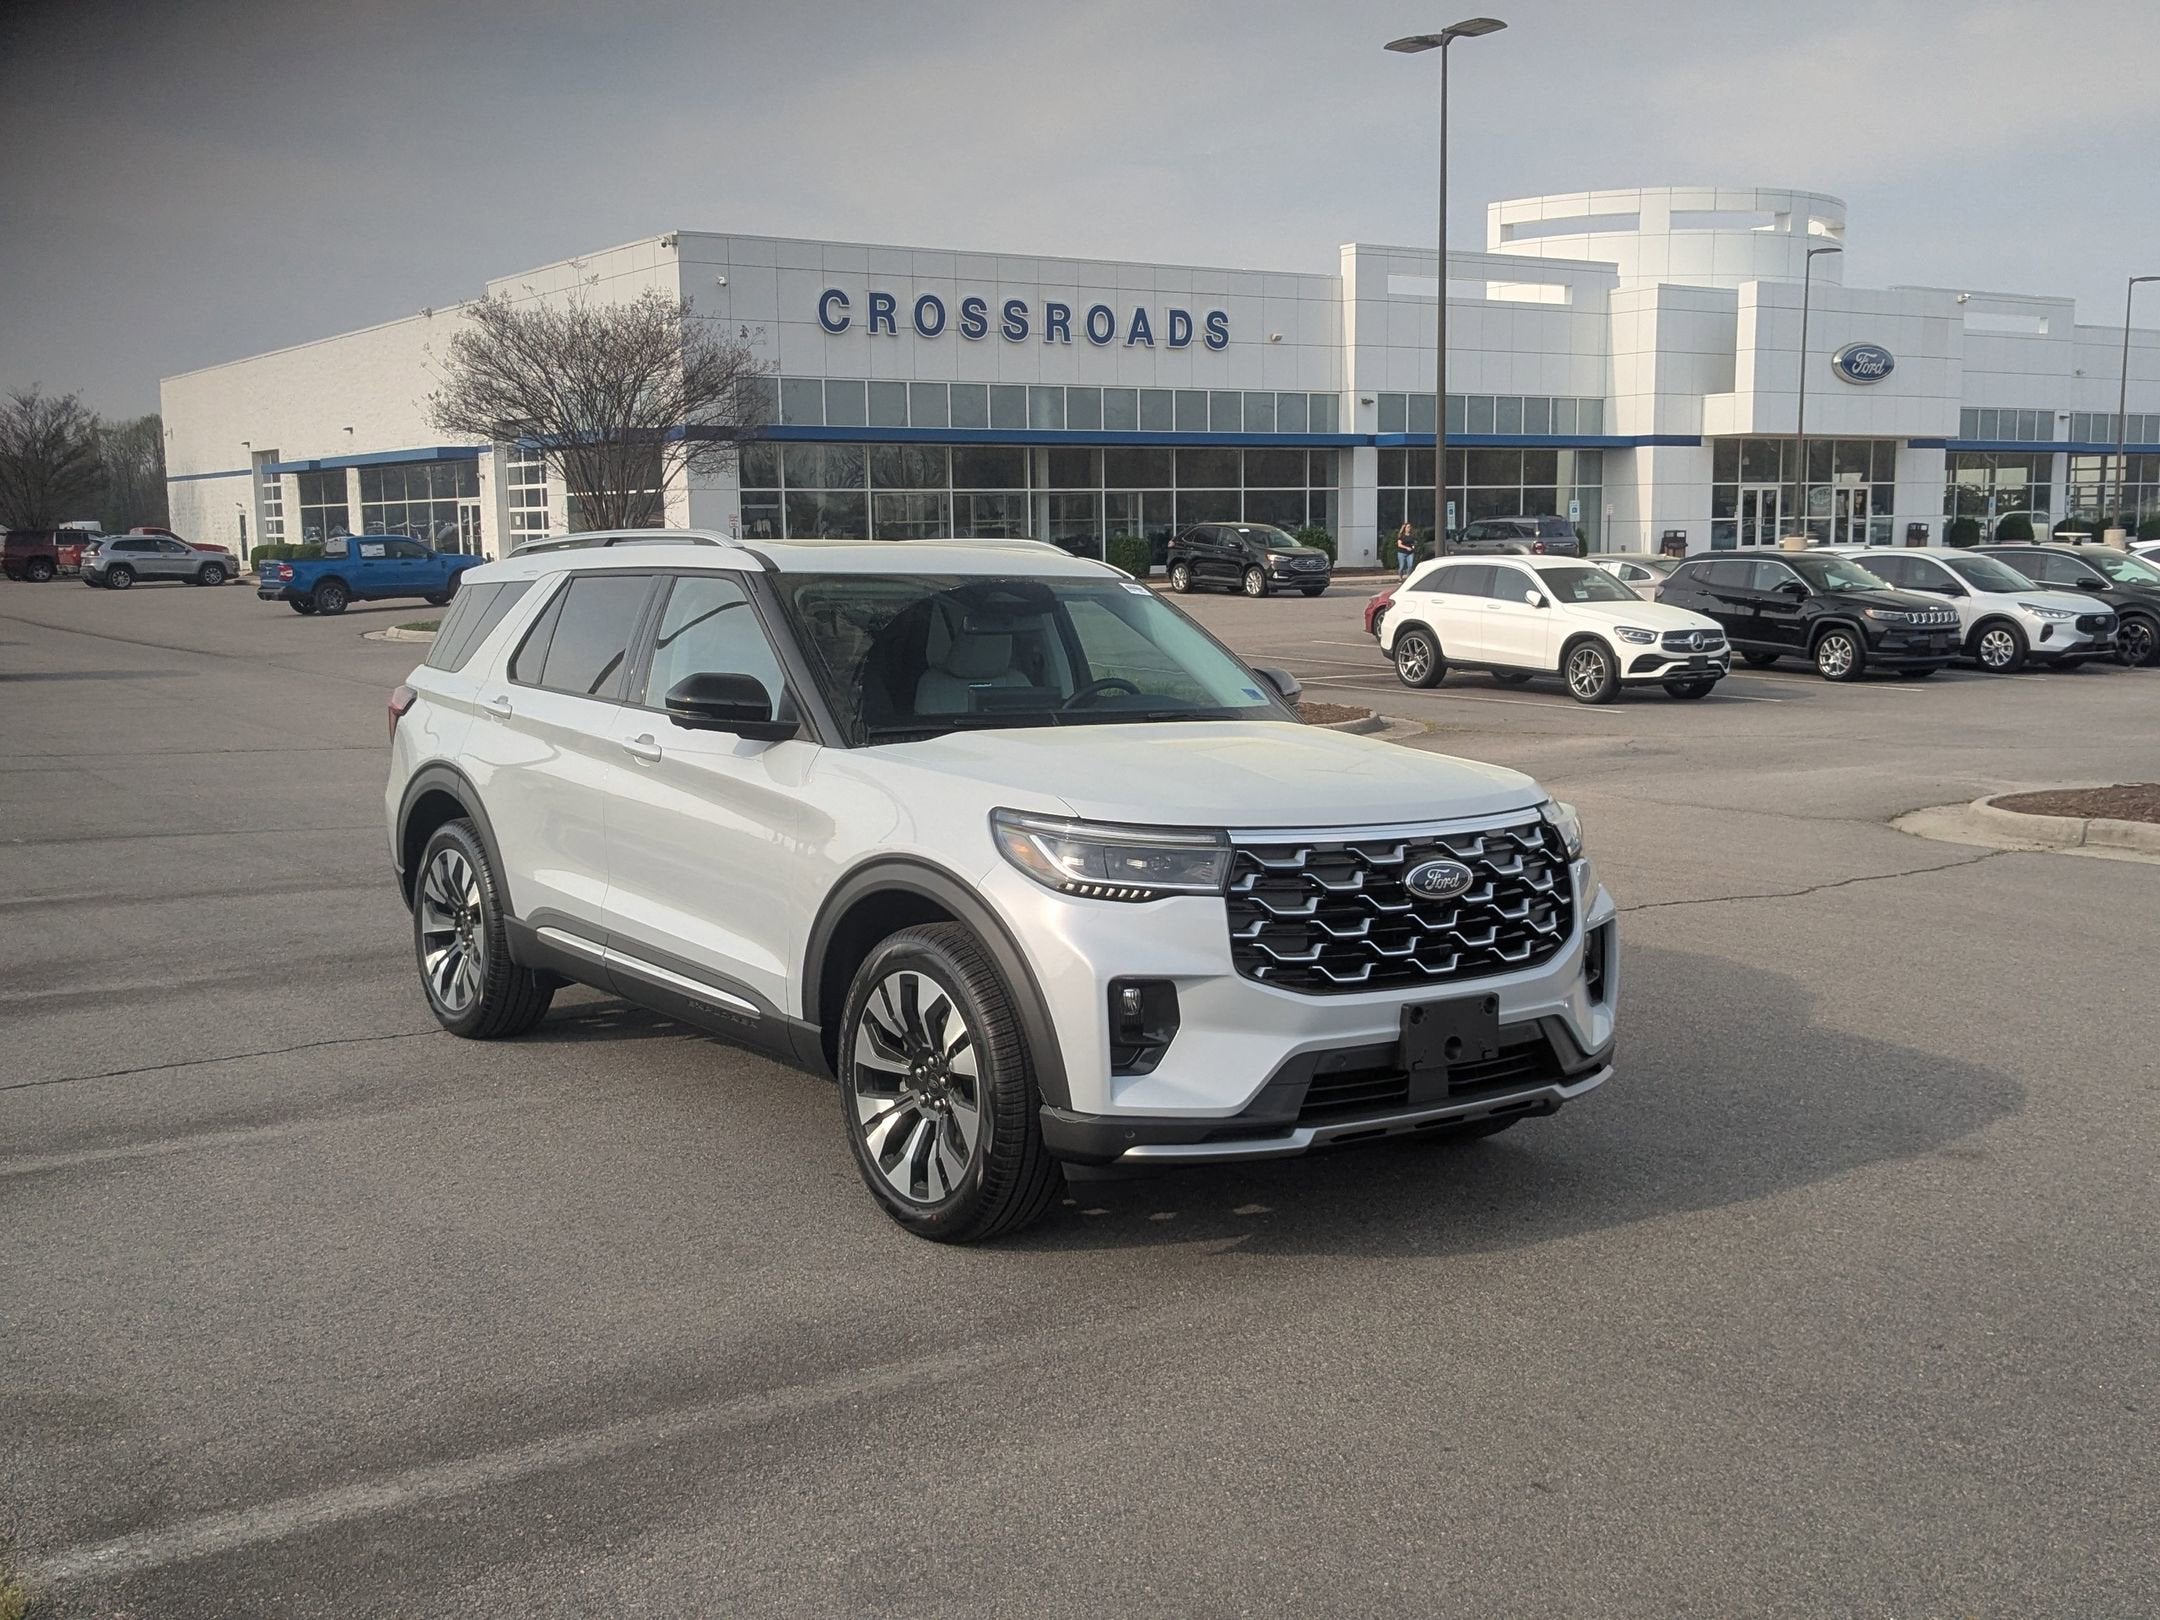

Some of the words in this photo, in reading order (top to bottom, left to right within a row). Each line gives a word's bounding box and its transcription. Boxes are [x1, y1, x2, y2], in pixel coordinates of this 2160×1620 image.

[818, 288, 1230, 351] CROSSROADS
[1851, 351, 1886, 375] Ford
[1424, 868, 1460, 890] Ford
